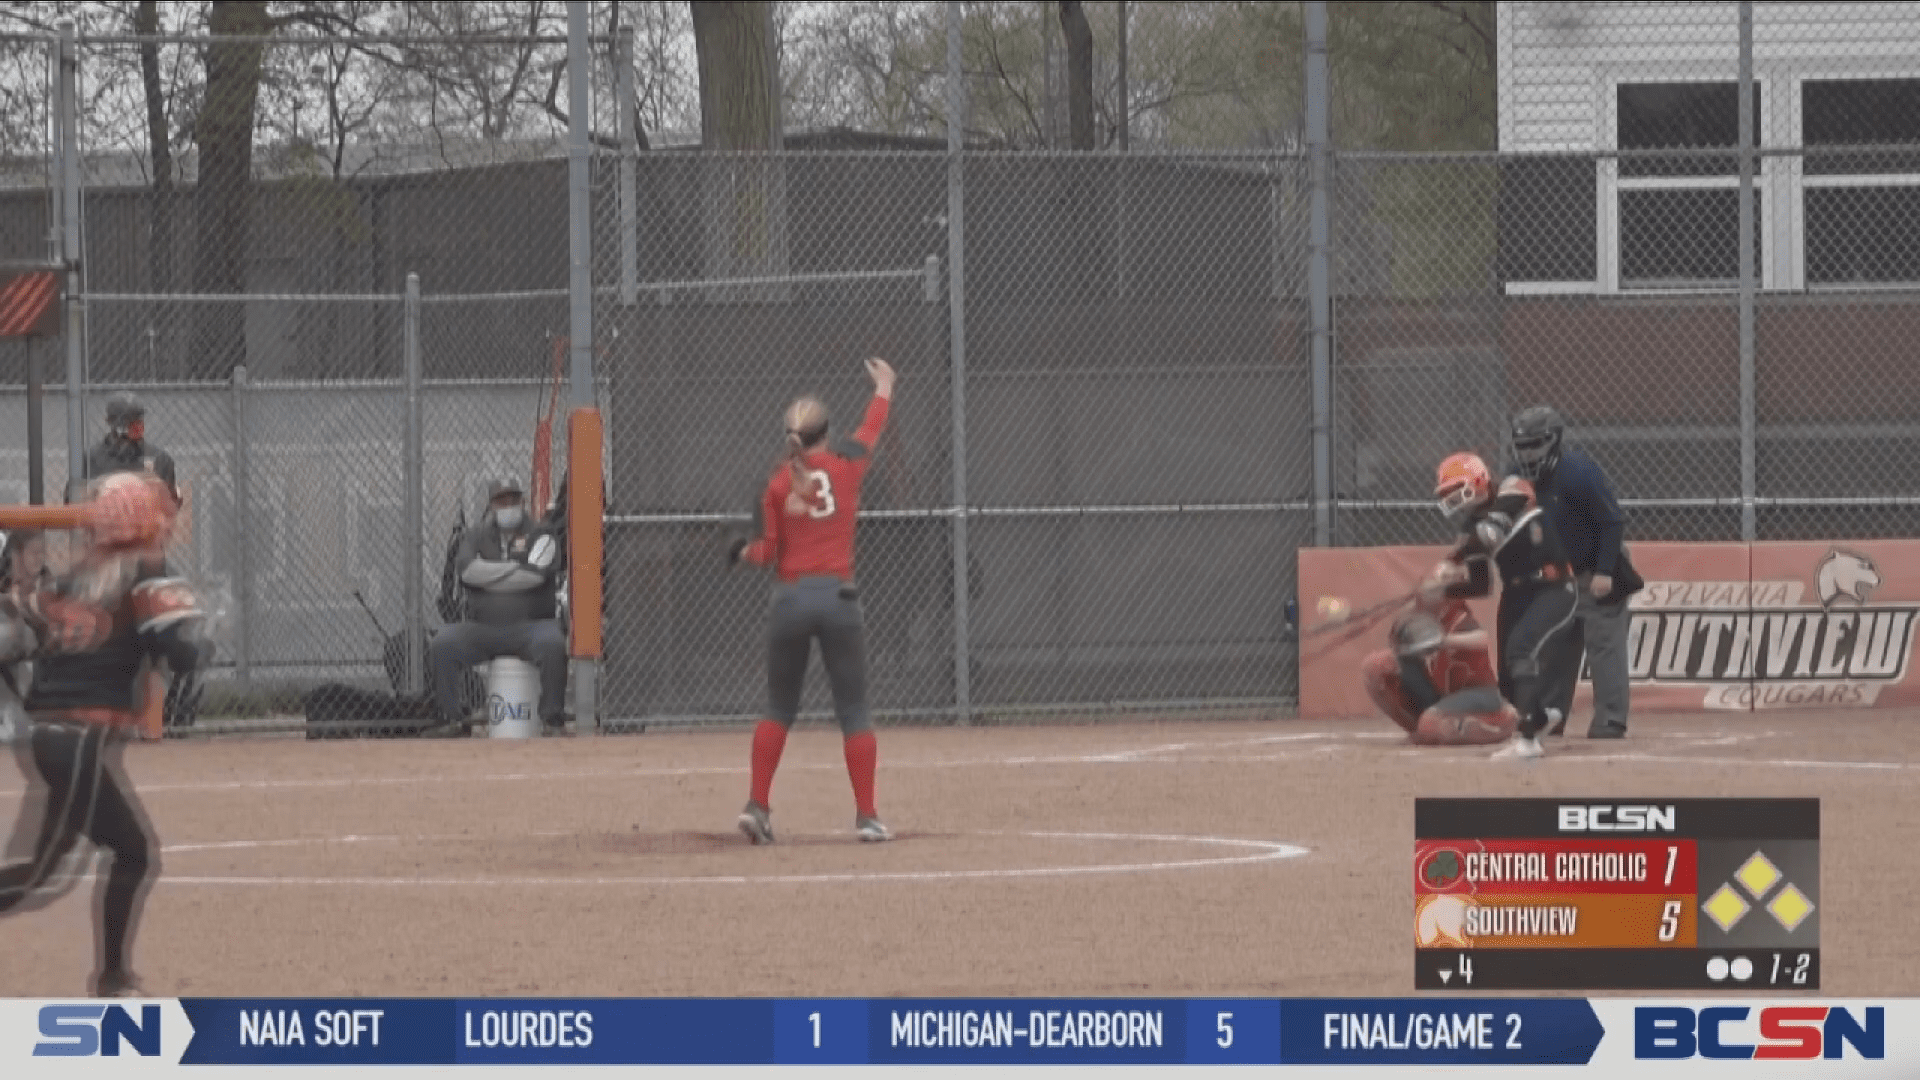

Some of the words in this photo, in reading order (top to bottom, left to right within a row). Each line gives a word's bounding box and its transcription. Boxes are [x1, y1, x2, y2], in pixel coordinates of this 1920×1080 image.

[808, 470, 835, 518] 3
[1641, 583, 1790, 606] SYLVANIA
[1627, 611, 1916, 678] OUTHVIEW
[1718, 684, 1866, 704] COUGARS
